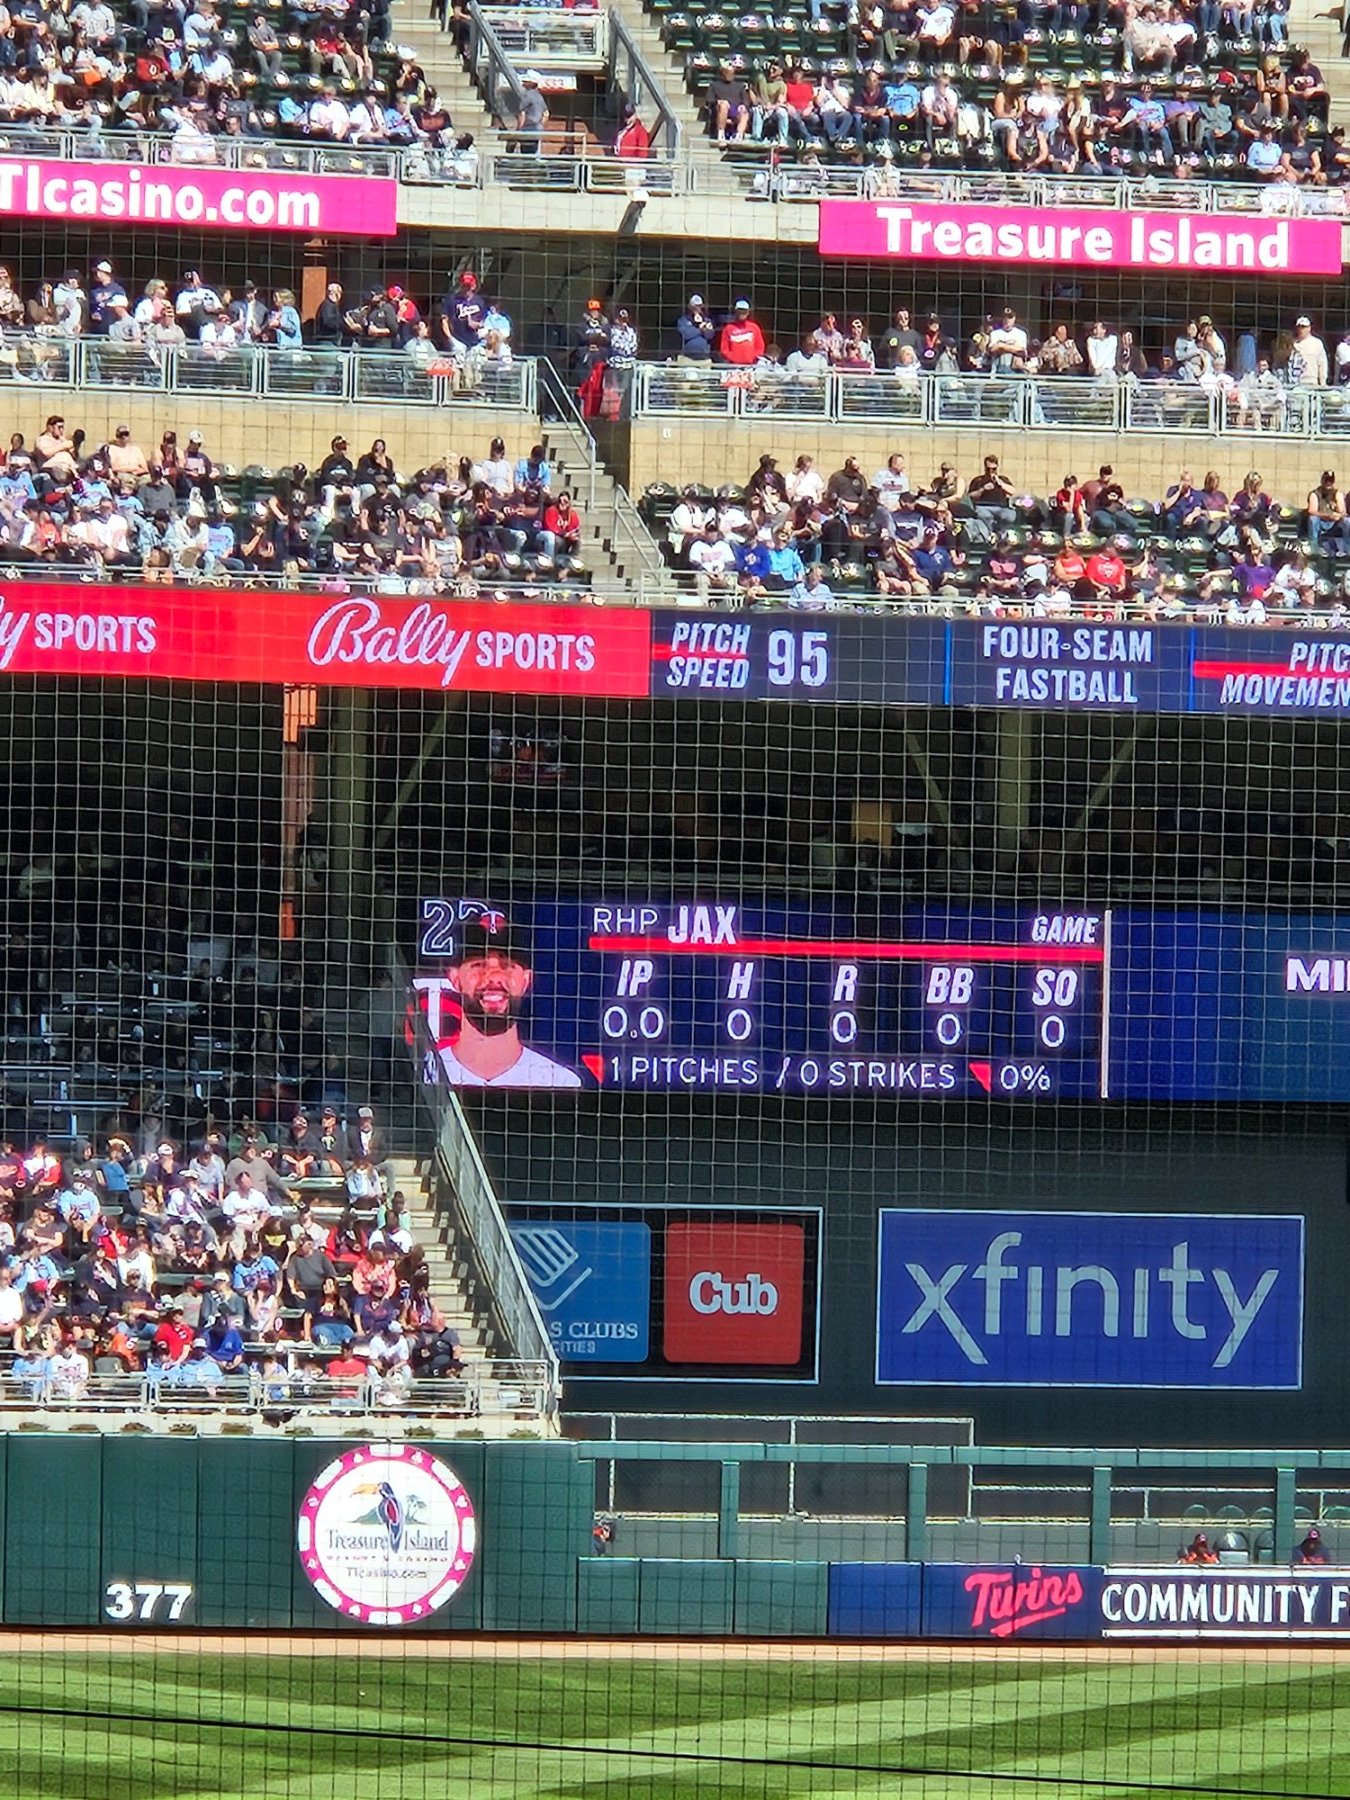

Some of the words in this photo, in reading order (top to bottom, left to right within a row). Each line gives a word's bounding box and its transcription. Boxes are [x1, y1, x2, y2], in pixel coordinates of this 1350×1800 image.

[876, 206, 1113, 261] Treasure
[1131, 217, 1289, 268] Island
[35, 613, 157, 653] SPORTS
[307, 597, 471, 687] Bally
[476, 631, 595, 671] SPORTS
[671, 622, 751, 655] PITCH
[983, 626, 1152, 662] FOUR-SEAM
[666, 656, 750, 689] SPEED
[768, 629, 828, 687] 95
[1289, 642, 1350, 673] PITC
[996, 667, 1138, 703] FASTBALL
[593, 908, 658, 935] RHP
[668, 906, 736, 945] JAX
[1032, 915, 1099, 944] GAME
[616, 959, 653, 996] IP
[727, 962, 754, 999] H
[833, 964, 858, 1002] R
[927, 967, 974, 1004] BB
[1032, 969, 1077, 1007] SO
[1286, 958, 1350, 992] MI
[603, 1005, 664, 1039] 0.0
[727, 1008, 752, 1040] 0
[832, 1011, 856, 1043] 0
[936, 1013, 962, 1045] 0
[1041, 1015, 1065, 1047] 0
[611, 1057, 621, 1083] 1
[631, 1057, 758, 1086] PITCHES
[828, 1061, 956, 1090] STRIKES
[1000, 1063, 1051, 1091] 0%
[689, 1271, 778, 1315] Cub
[902, 1231, 1279, 1368] xfinity
[568, 1322, 639, 1339] CLUBS
[325, 1529, 389, 1551] Treasure
[404, 1529, 449, 1551] Island
[105, 1583, 192, 1620] 377
[964, 1567, 1084, 1638] Twins
[1101, 1583, 1320, 1623] COMMUNITY
